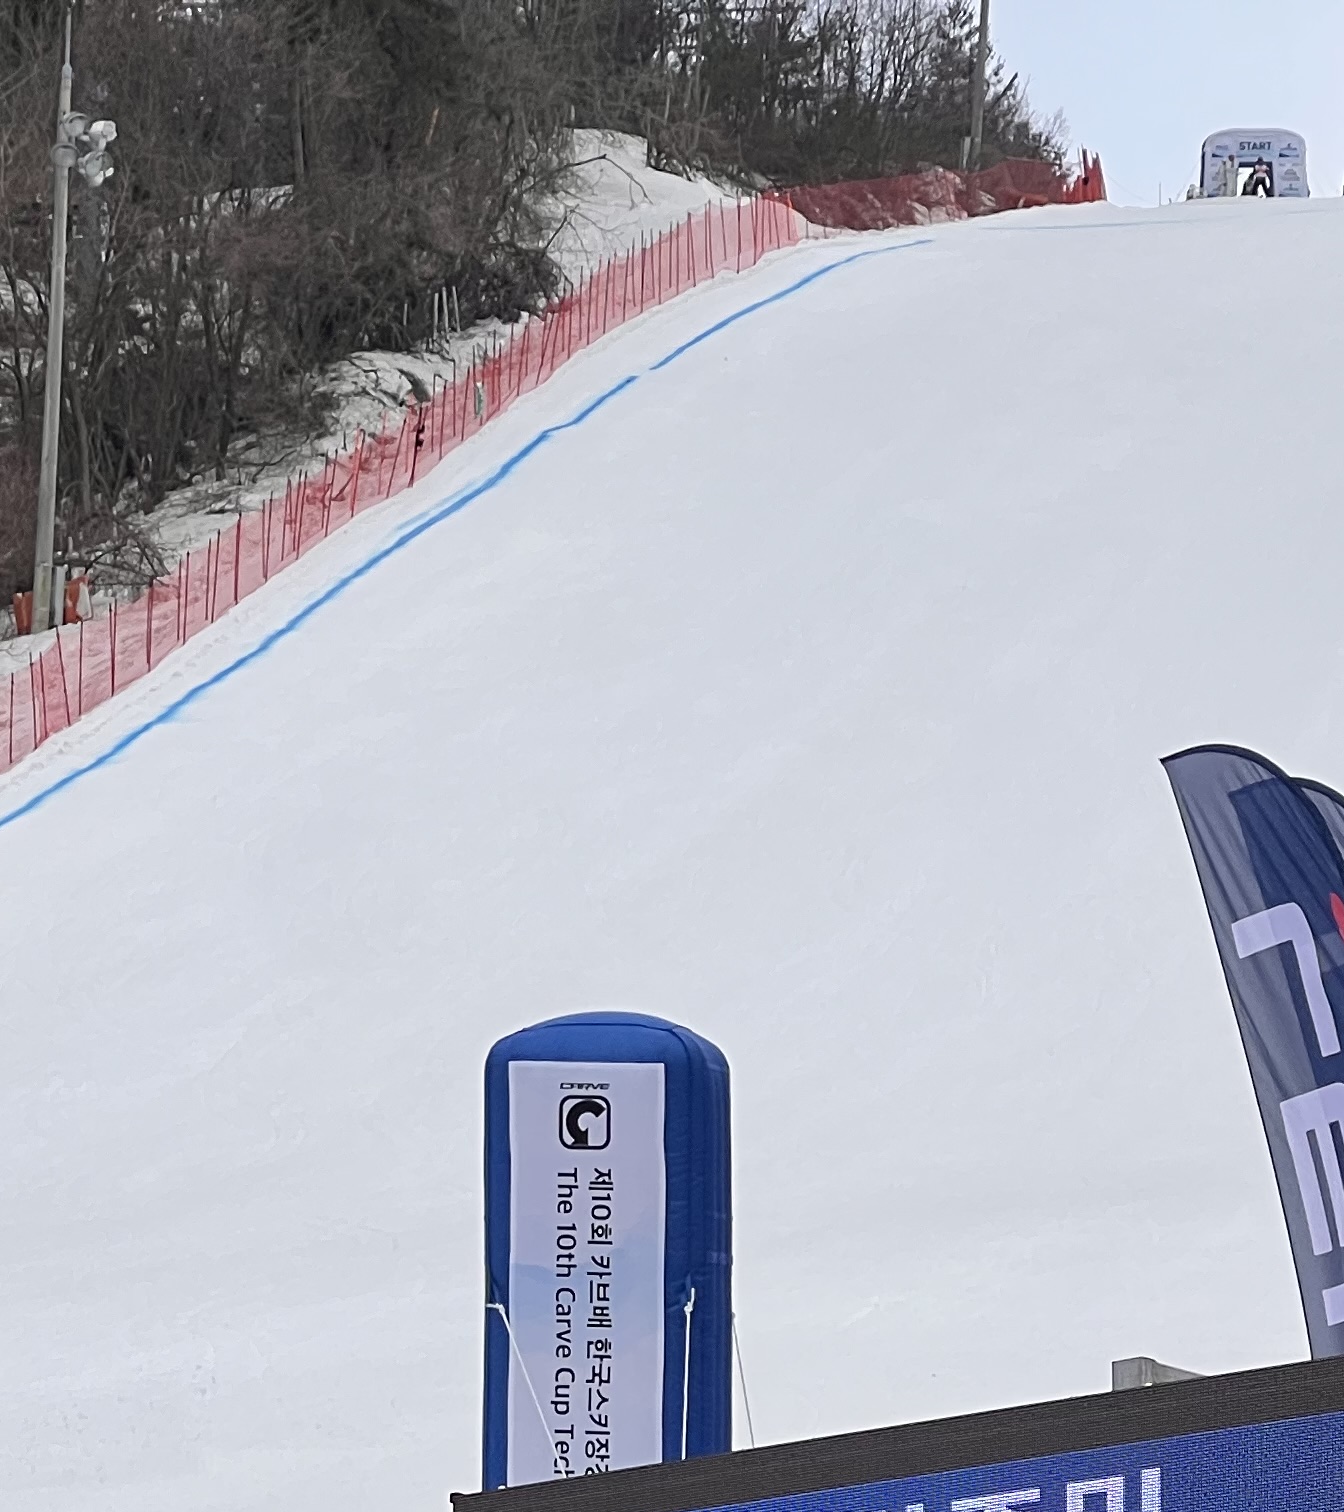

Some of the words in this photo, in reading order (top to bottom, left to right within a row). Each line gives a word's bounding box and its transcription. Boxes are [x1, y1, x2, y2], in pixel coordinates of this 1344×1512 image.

[1239, 141, 1272, 151] START
[559, 1082, 611, 1091] CARVE
[556, 1166, 579, 1214] The
[587, 1167, 614, 1246] 제10회
[555, 1222, 578, 1278] 10th
[586, 1255, 613, 1328] 카브배
[555, 1287, 576, 1359] Carve
[550, 1367, 576, 1416] Cup
